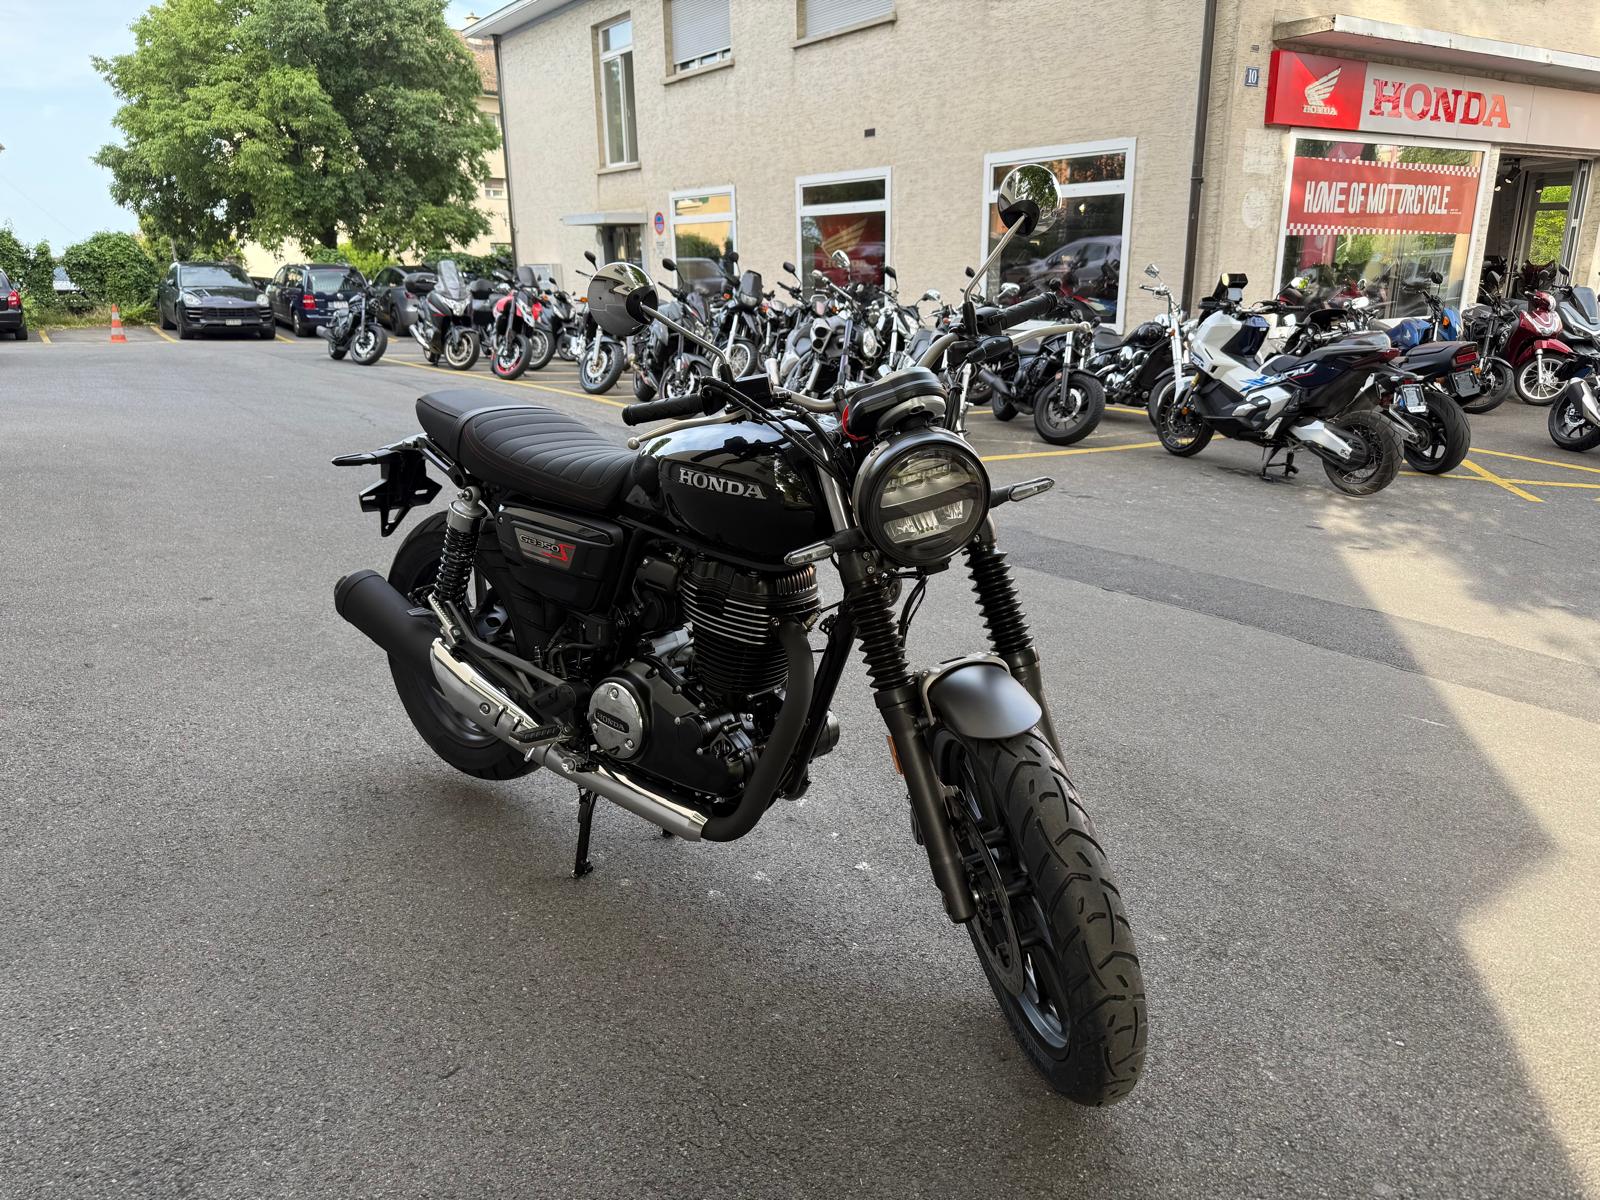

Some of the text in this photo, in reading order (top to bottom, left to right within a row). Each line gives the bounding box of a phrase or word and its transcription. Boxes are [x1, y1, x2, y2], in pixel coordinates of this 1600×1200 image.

[1248, 69, 1257, 83] 10
[1302, 104, 1338, 116] HONDA
[1369, 78, 1511, 129] HONDA
[1304, 180, 1348, 214] HOME
[1348, 182, 1366, 215] OF
[679, 467, 767, 500] HONDA
[597, 712, 625, 731] HONDA
